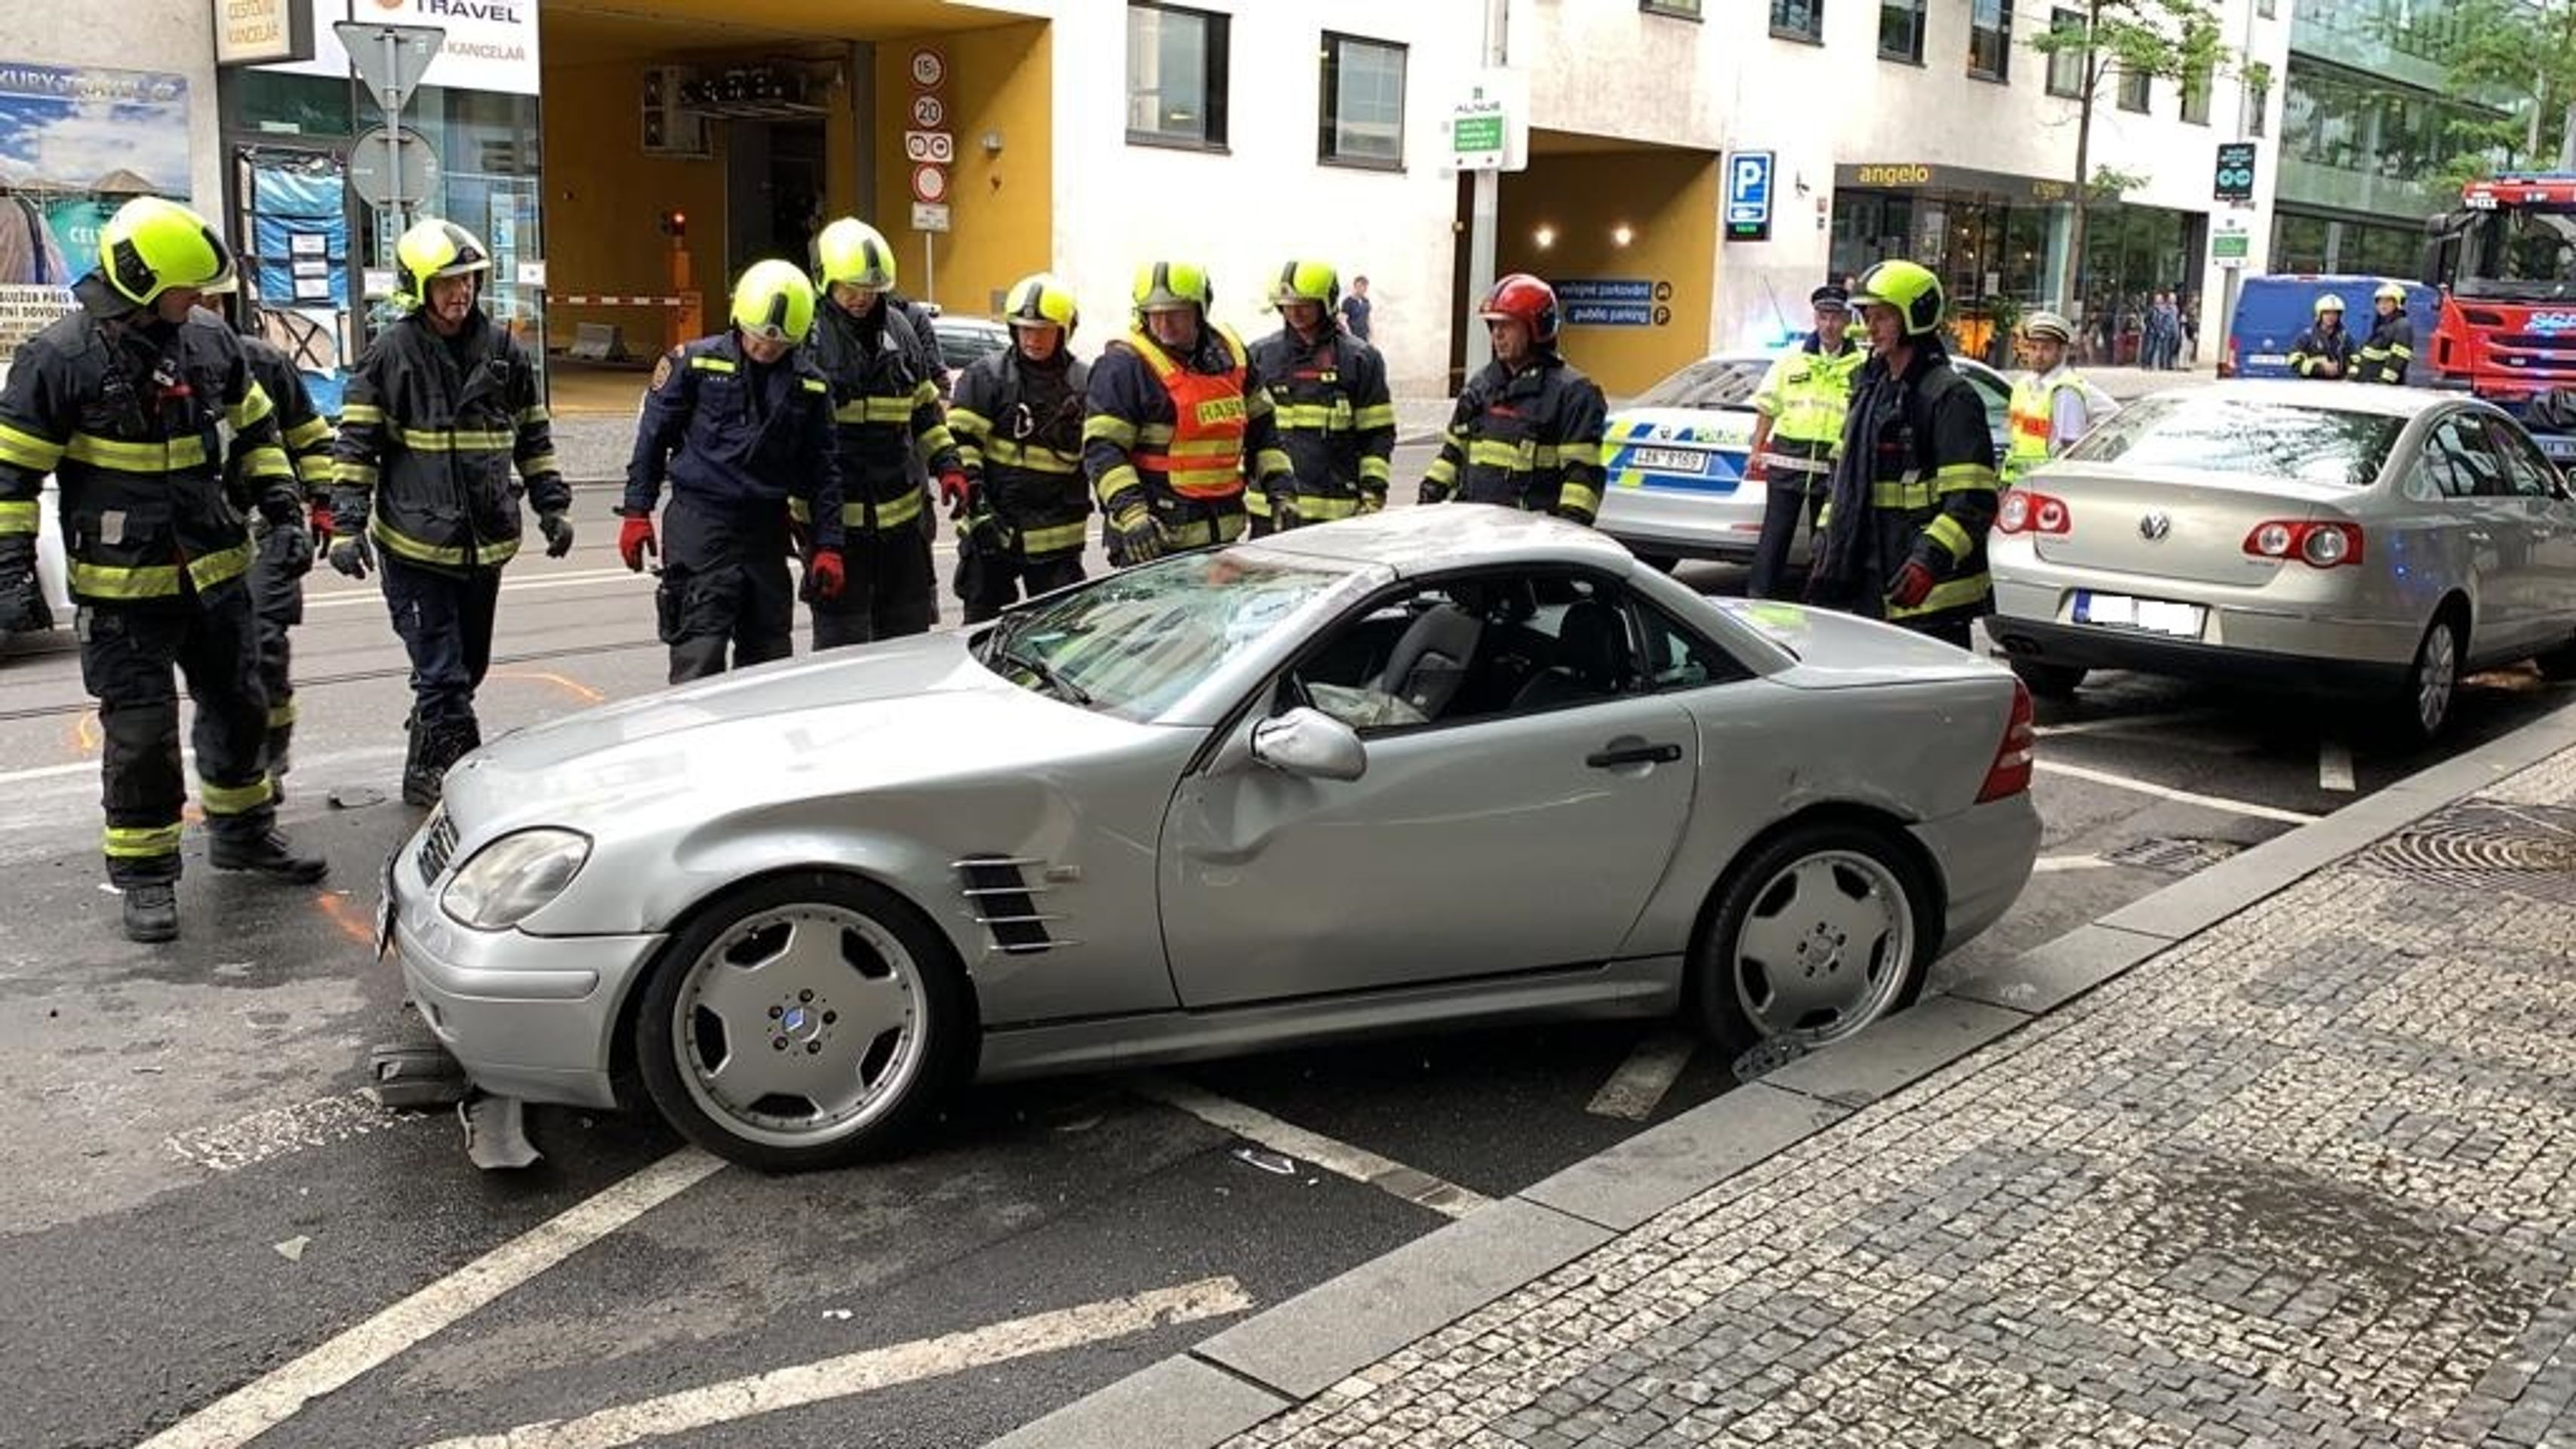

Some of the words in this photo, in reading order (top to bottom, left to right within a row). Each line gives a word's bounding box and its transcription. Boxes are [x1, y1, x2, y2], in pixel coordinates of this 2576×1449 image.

[416, 0, 522, 23] TRAVEL
[918, 101, 940, 122] 20
[1737, 161, 1762, 199] P
[1859, 164, 1929, 186] angelo
